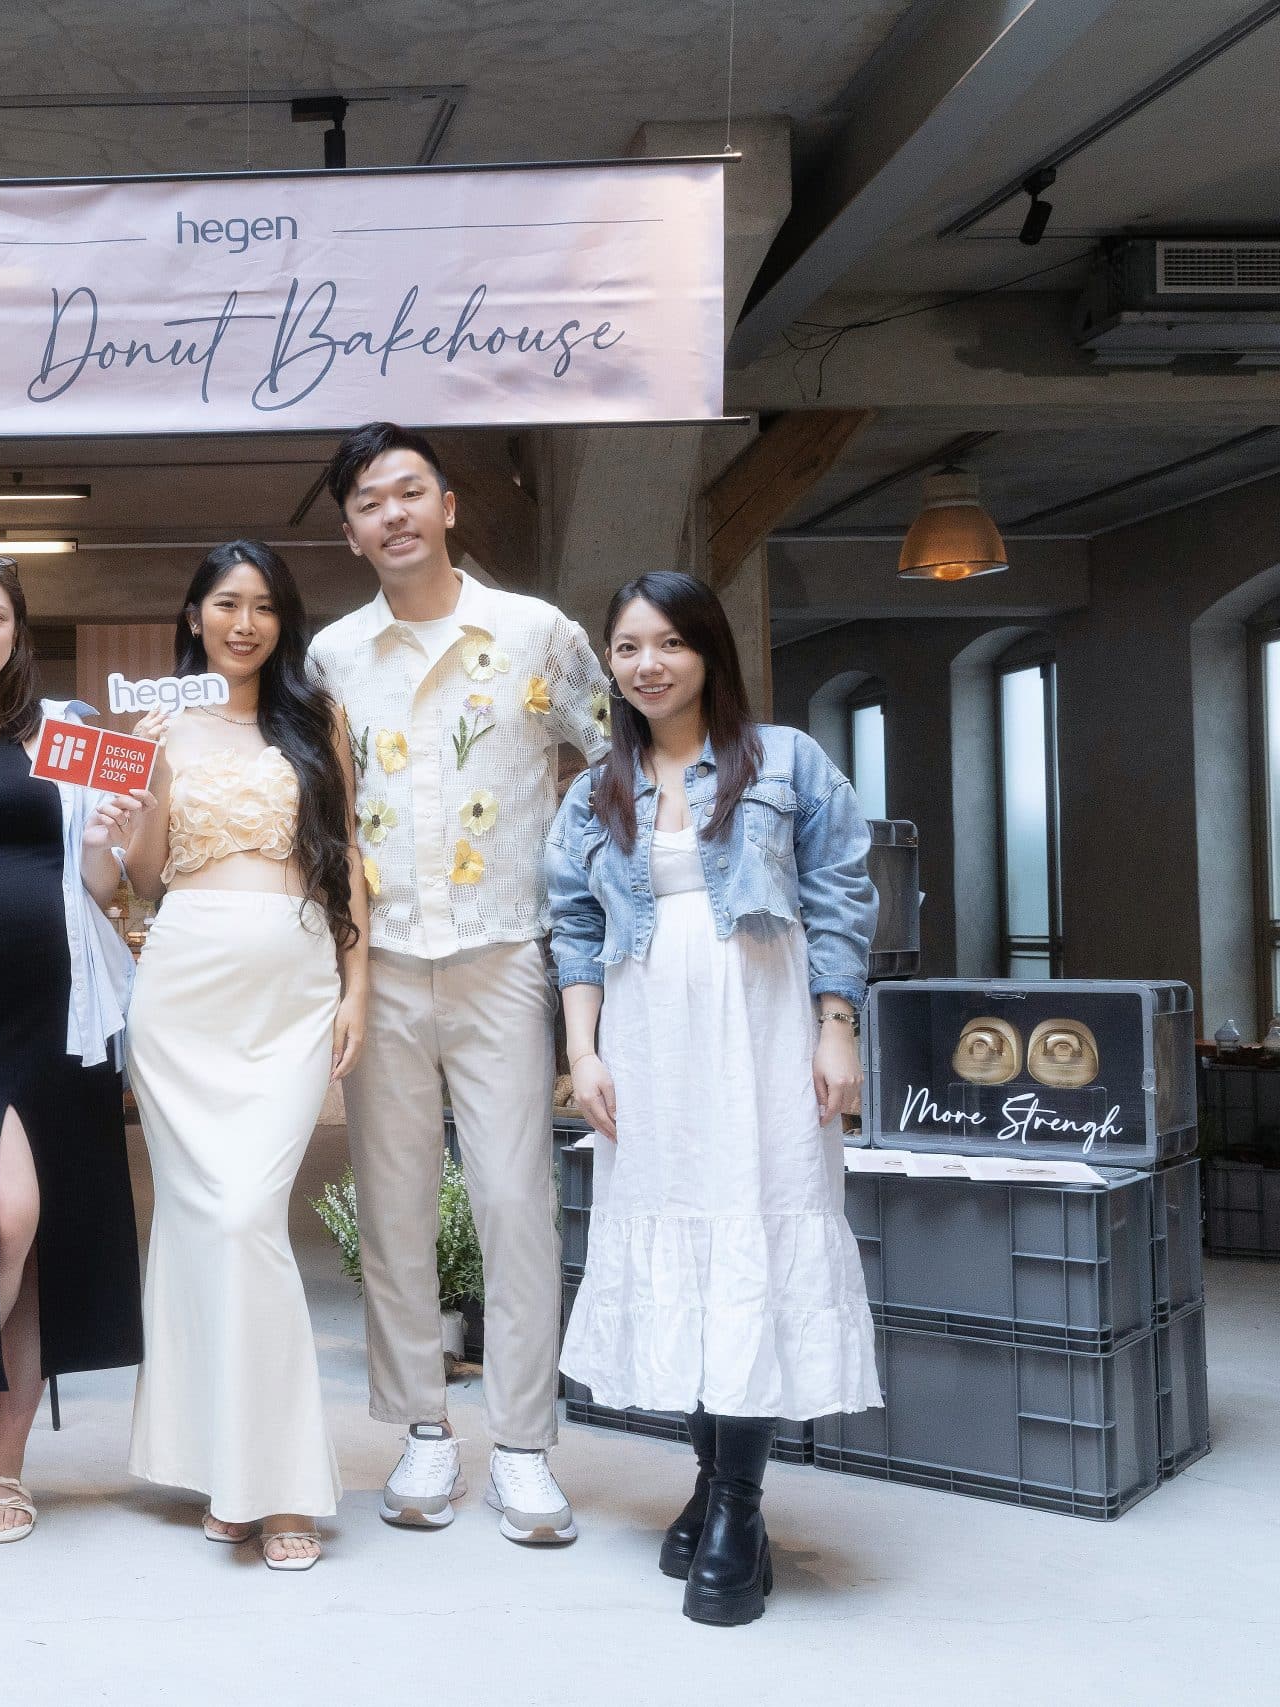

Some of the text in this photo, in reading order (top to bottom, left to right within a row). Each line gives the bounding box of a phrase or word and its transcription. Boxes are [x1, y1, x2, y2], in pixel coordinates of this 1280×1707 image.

[176, 211, 298, 254] hegen
[26, 286, 276, 404] Donut
[251, 277, 626, 412] Bakehouse
[113, 678, 224, 713] hegen
[102, 757, 145, 774] AWARD
[105, 744, 146, 762] DESIGN
[99, 768, 127, 783] 2026
[899, 1084, 1123, 1154] More Strengh
